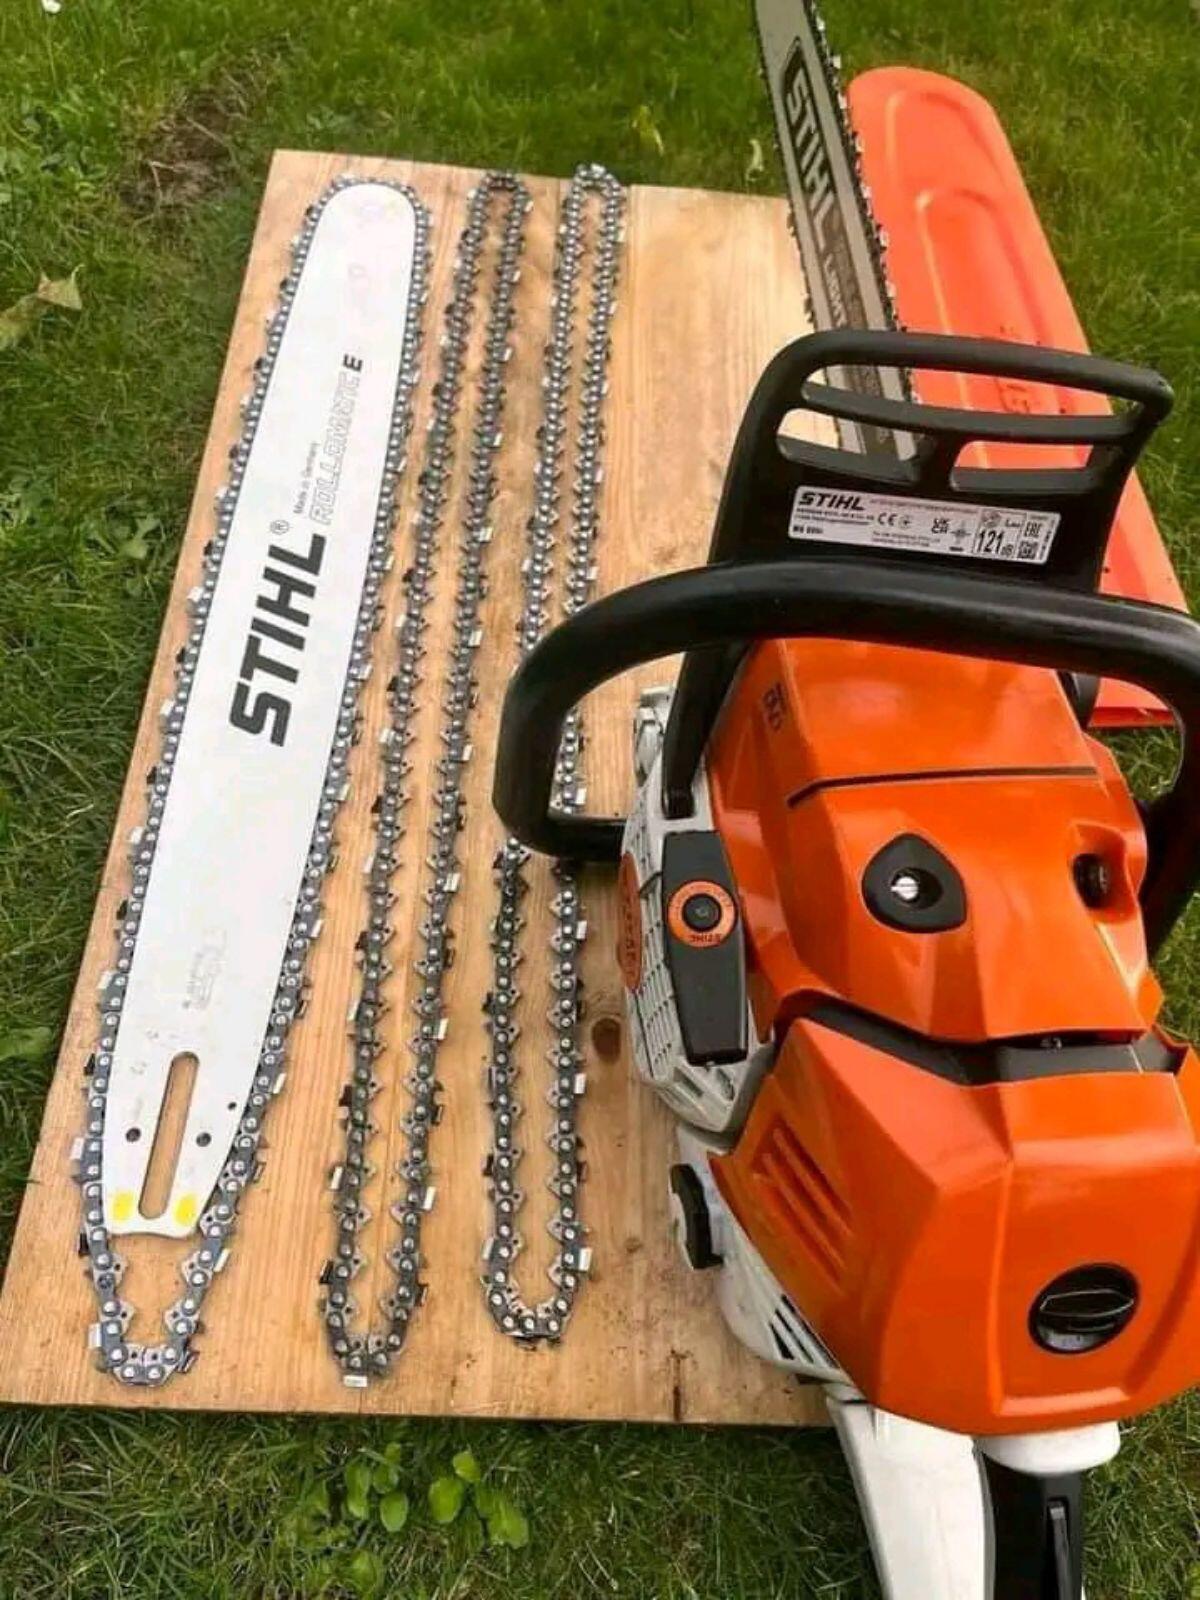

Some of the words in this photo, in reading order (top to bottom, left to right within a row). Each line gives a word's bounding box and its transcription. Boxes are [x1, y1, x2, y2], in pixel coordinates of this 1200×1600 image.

[786, 66, 835, 248] STIHL
[343, 354, 363, 373] E
[798, 491, 865, 511] STIHL
[979, 528, 1004, 555] 121
[229, 534, 327, 747] STIHL
